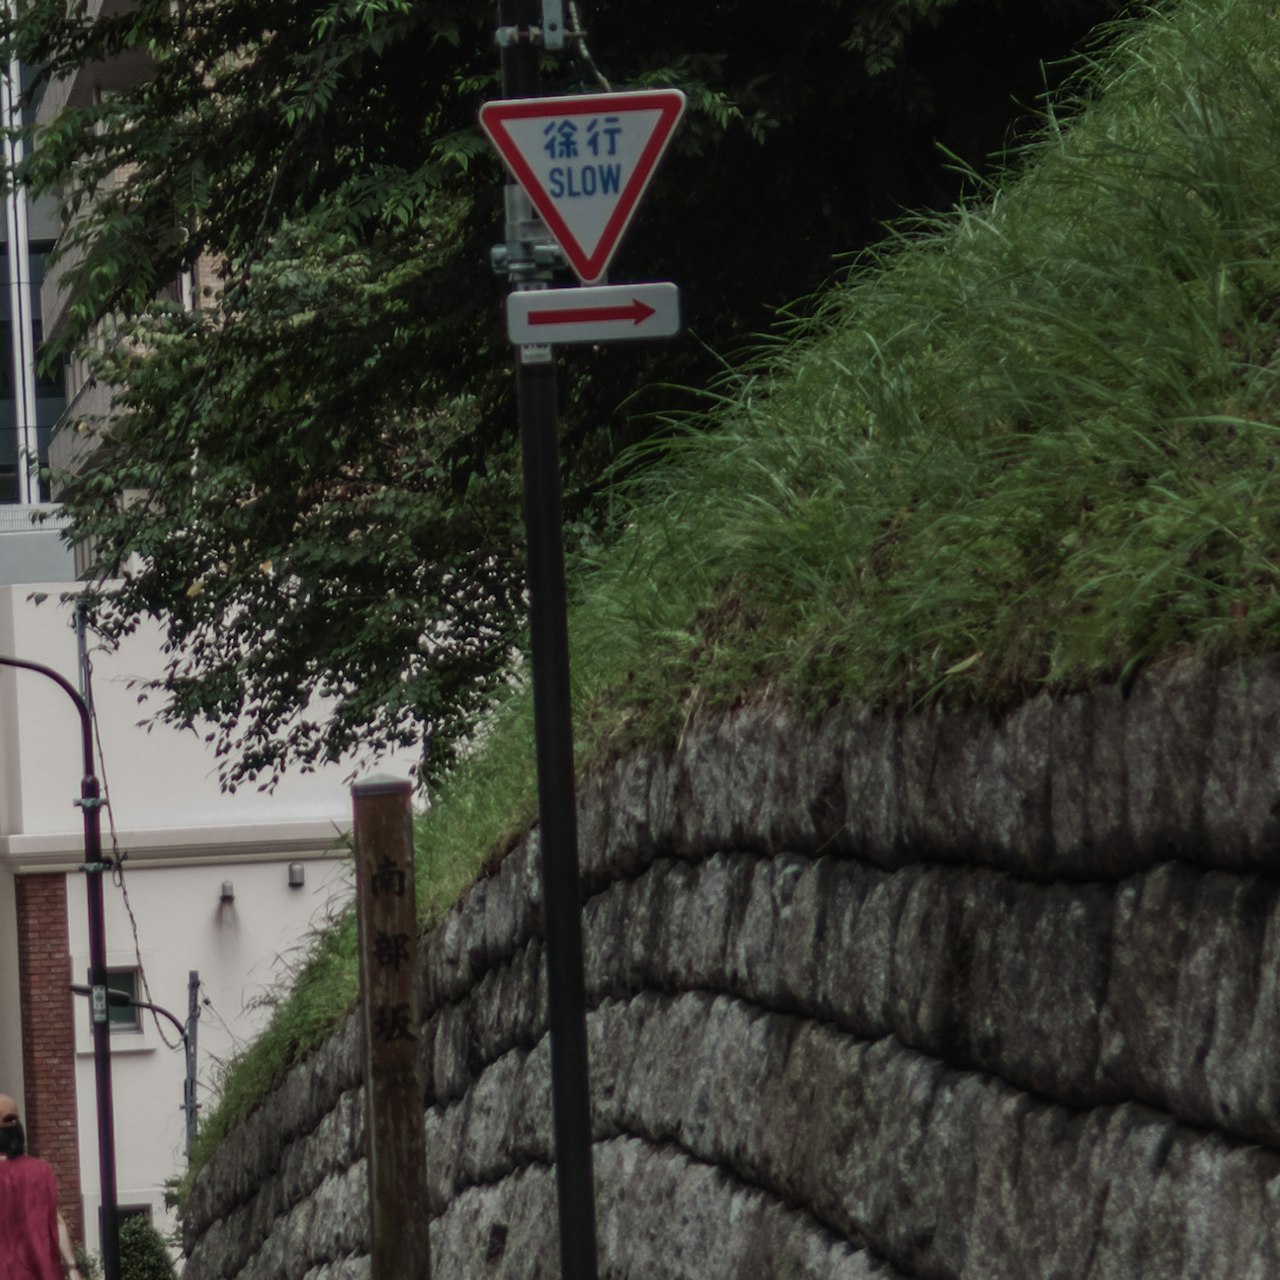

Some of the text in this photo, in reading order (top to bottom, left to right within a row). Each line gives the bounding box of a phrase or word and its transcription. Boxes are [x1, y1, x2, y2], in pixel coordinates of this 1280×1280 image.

[543, 116, 622, 159] 徐行
[549, 164, 622, 198] SLOW
[371, 855, 417, 1042] 南部坂
